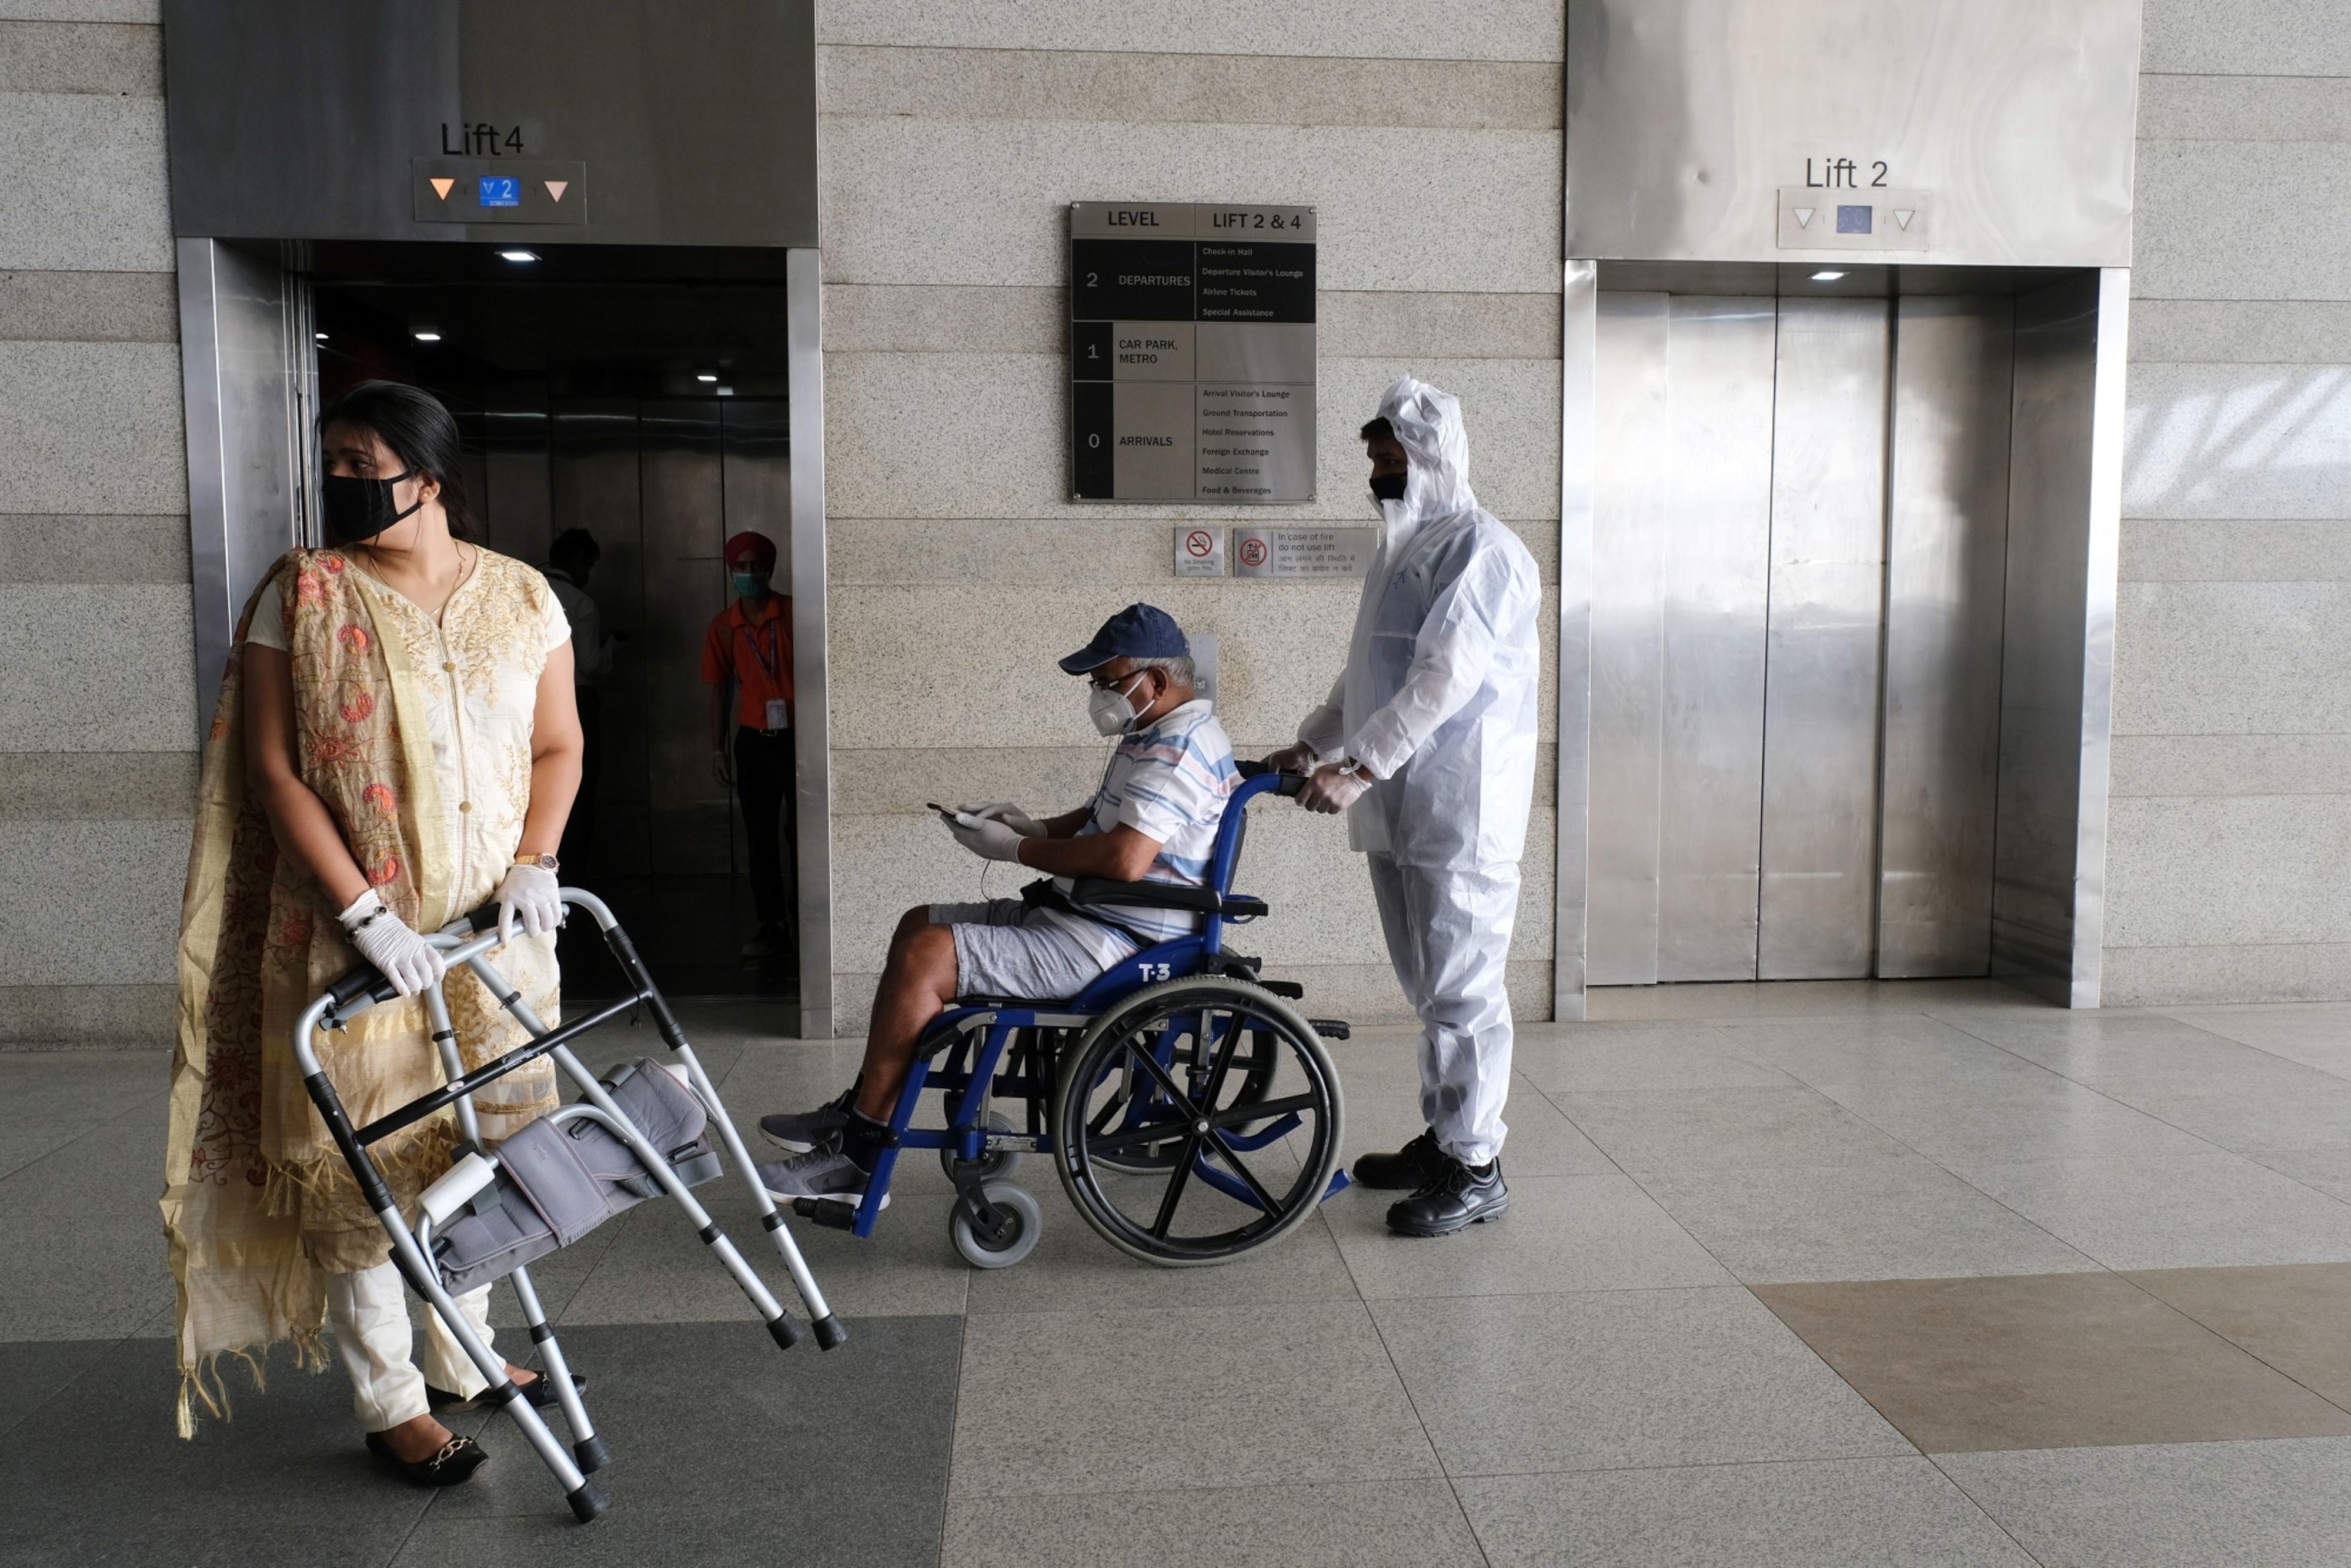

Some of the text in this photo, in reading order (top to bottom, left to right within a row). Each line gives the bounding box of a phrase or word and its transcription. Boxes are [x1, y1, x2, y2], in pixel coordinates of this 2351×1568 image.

[1806, 158, 1888, 188] Lift 2
[502, 179, 512, 198] 2
[1108, 211, 1160, 226] LEVEL
[1213, 212, 1301, 230] LIFT 2 & 4
[1202, 247, 1235, 255] Check-in
[1202, 268, 1304, 278] Departure Visitor's Lounge
[1087, 272, 1098, 287] 2
[1118, 275, 1191, 286] DEPARTURES
[1203, 287, 1228, 295] Airline
[1203, 307, 1274, 317] Special Assistance
[1119, 339, 1178, 351] CAR PARK,
[1088, 343, 1099, 359] 1
[1120, 353, 1157, 364] METRO
[1203, 389, 1228, 397] Arrival
[1262, 390, 1290, 399] Lounge
[1203, 409, 1288, 418] Ground Transportation
[1202, 428, 1274, 437] Hotel Reservations
[1088, 433, 1100, 449] 0
[1119, 436, 1173, 446] ARRIVALS
[1202, 447, 1269, 457] Foreign Exchange
[1202, 467, 1260, 475] Medical Centre
[1202, 486, 1271, 495] Food & Beverages
[1324, 543, 1335, 551] lift
